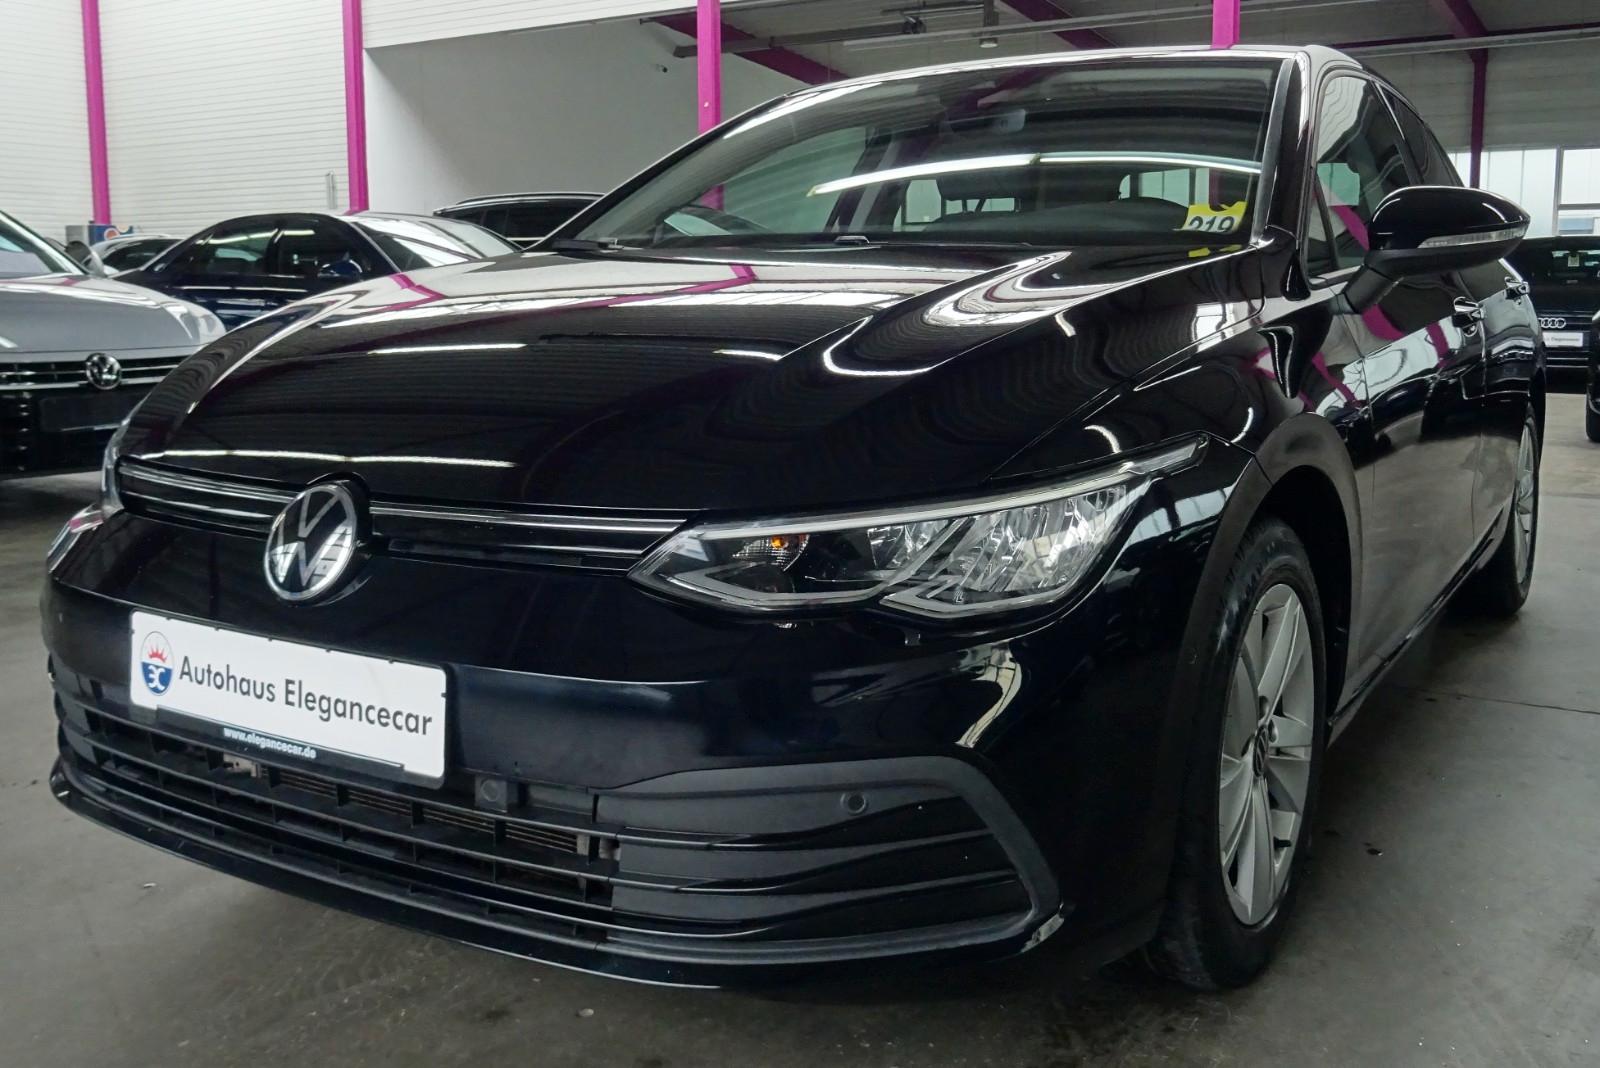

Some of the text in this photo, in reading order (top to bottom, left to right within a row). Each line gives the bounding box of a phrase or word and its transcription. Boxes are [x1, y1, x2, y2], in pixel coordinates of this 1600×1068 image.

[264, 484, 357, 600] VW
[179, 656, 433, 735] Autohaus Elegancecar
[223, 727, 317, 759] www.elegancecar.de
